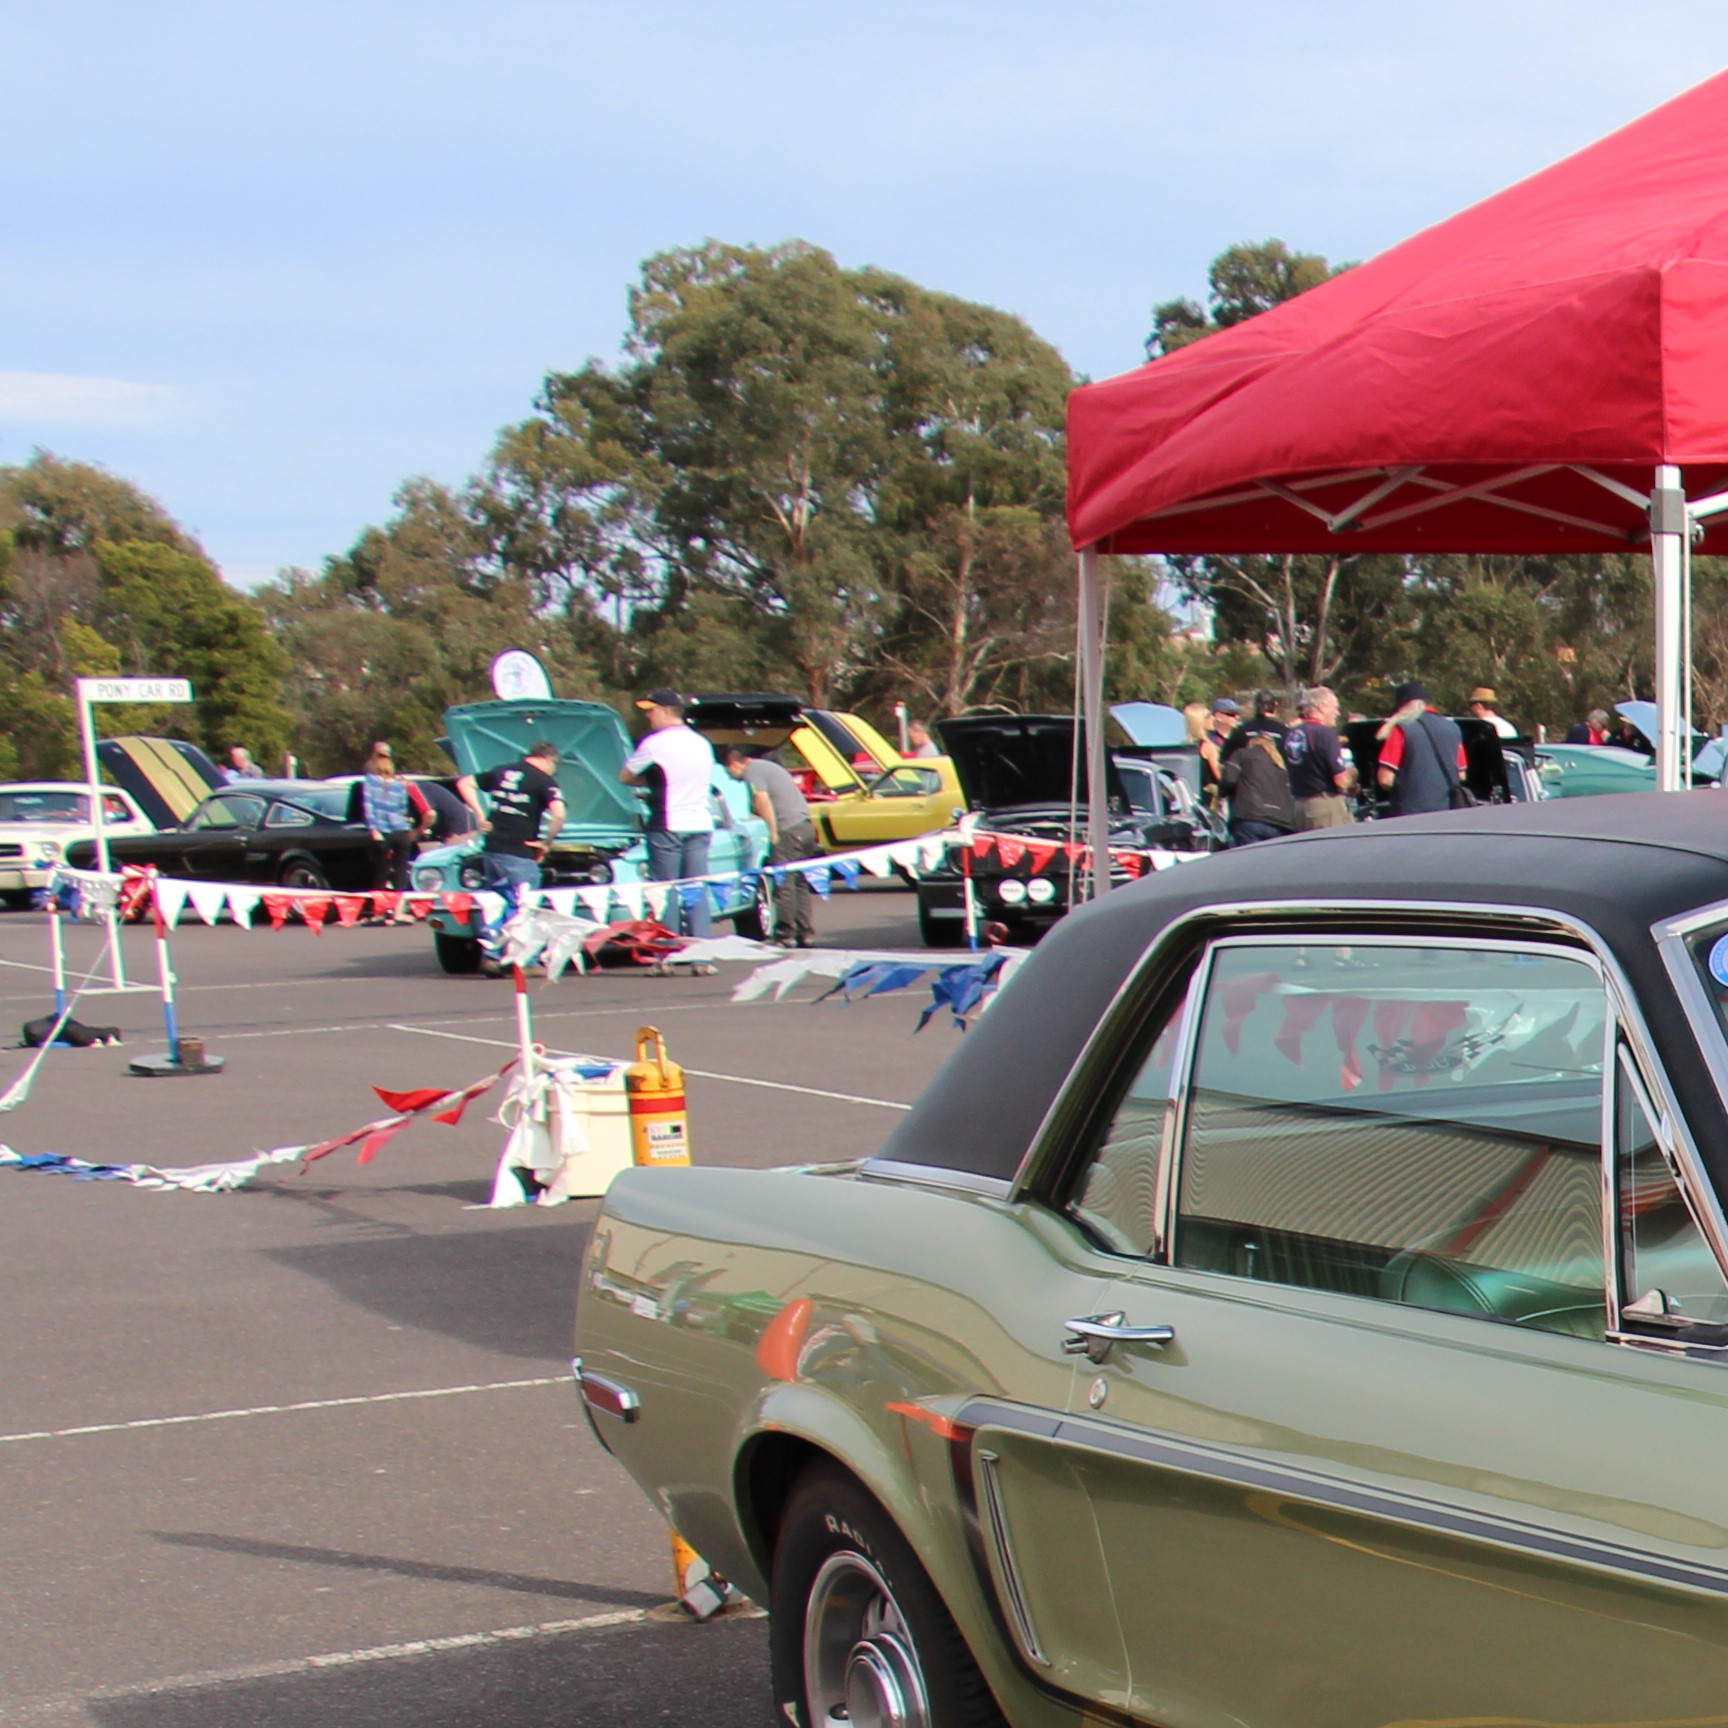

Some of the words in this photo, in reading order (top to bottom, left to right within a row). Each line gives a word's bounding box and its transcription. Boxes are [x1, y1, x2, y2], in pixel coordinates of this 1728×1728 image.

[97, 683, 130, 698] PONY
[139, 684, 162, 698] CAR
[167, 683, 185, 698] RD
